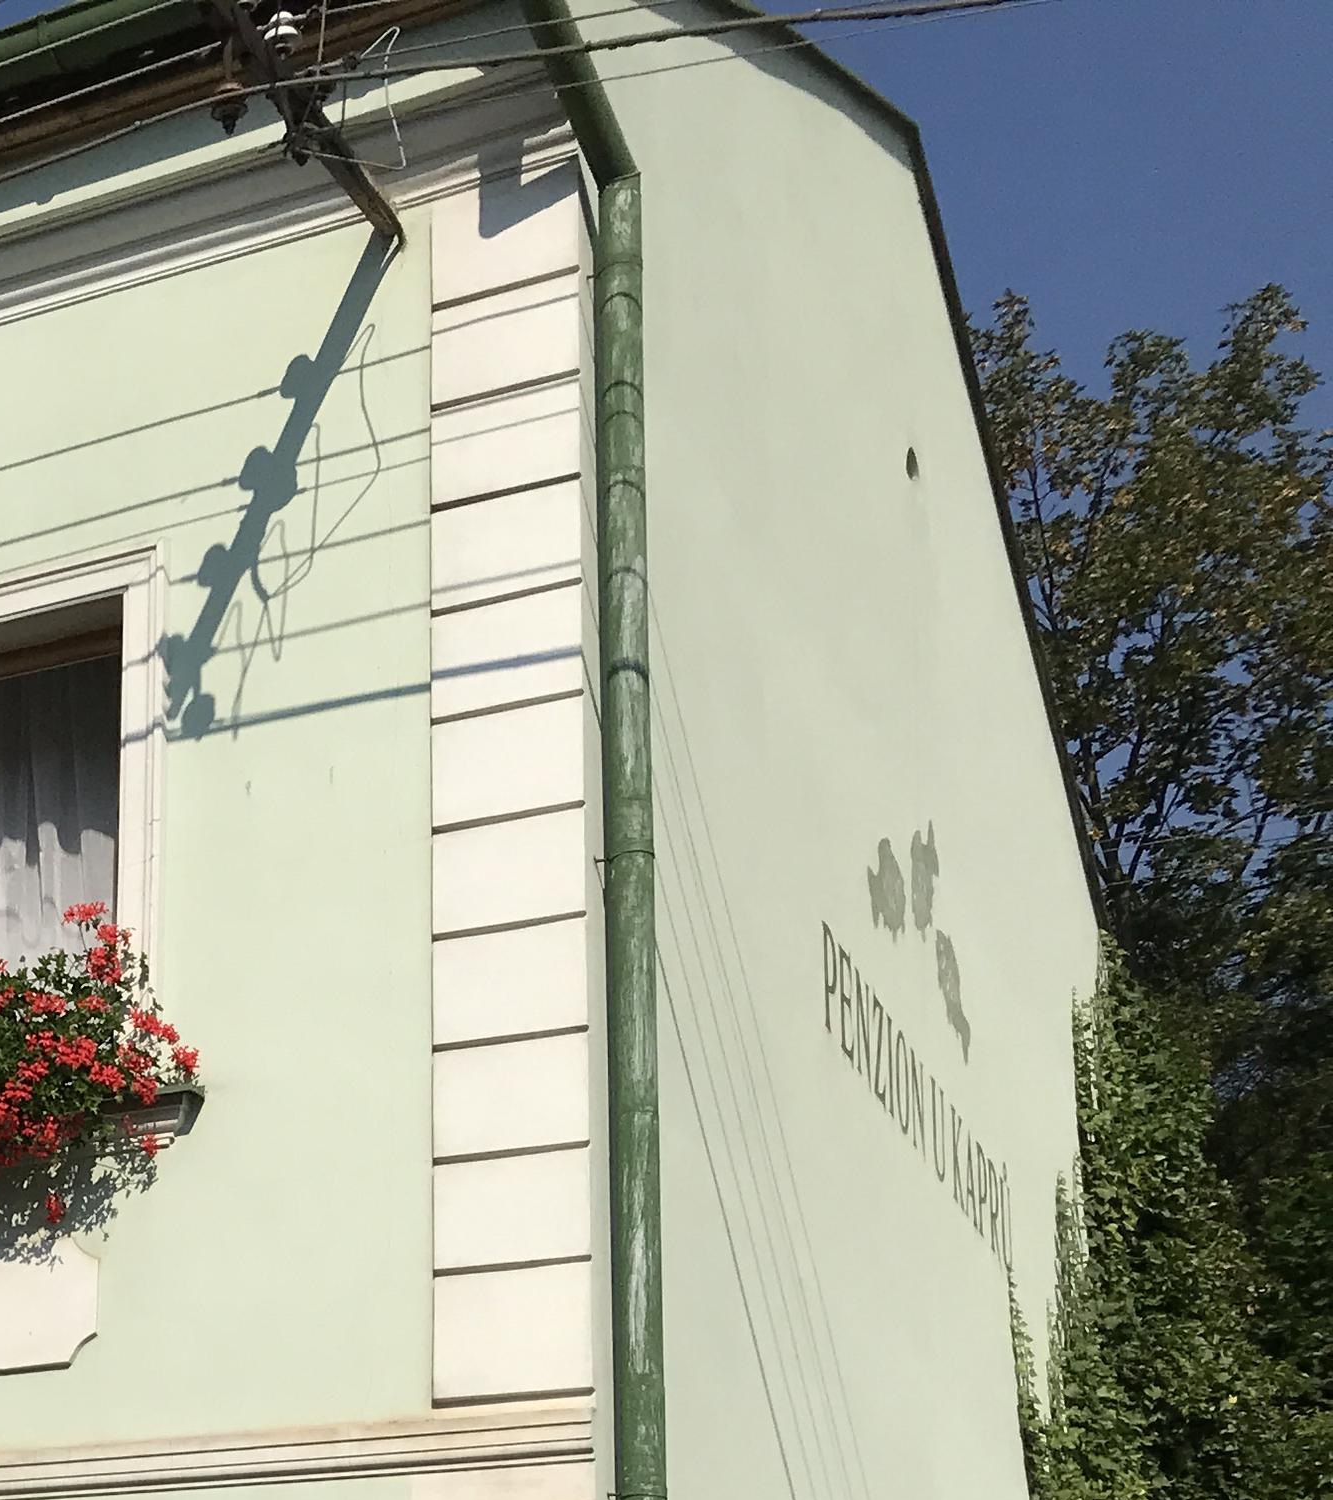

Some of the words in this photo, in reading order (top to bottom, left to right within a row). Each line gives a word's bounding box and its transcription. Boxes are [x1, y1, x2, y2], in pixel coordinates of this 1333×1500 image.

[822, 919, 926, 1160] PENZION
[929, 1075, 947, 1183] U
[950, 1103, 1014, 1271] KAPRŮ
